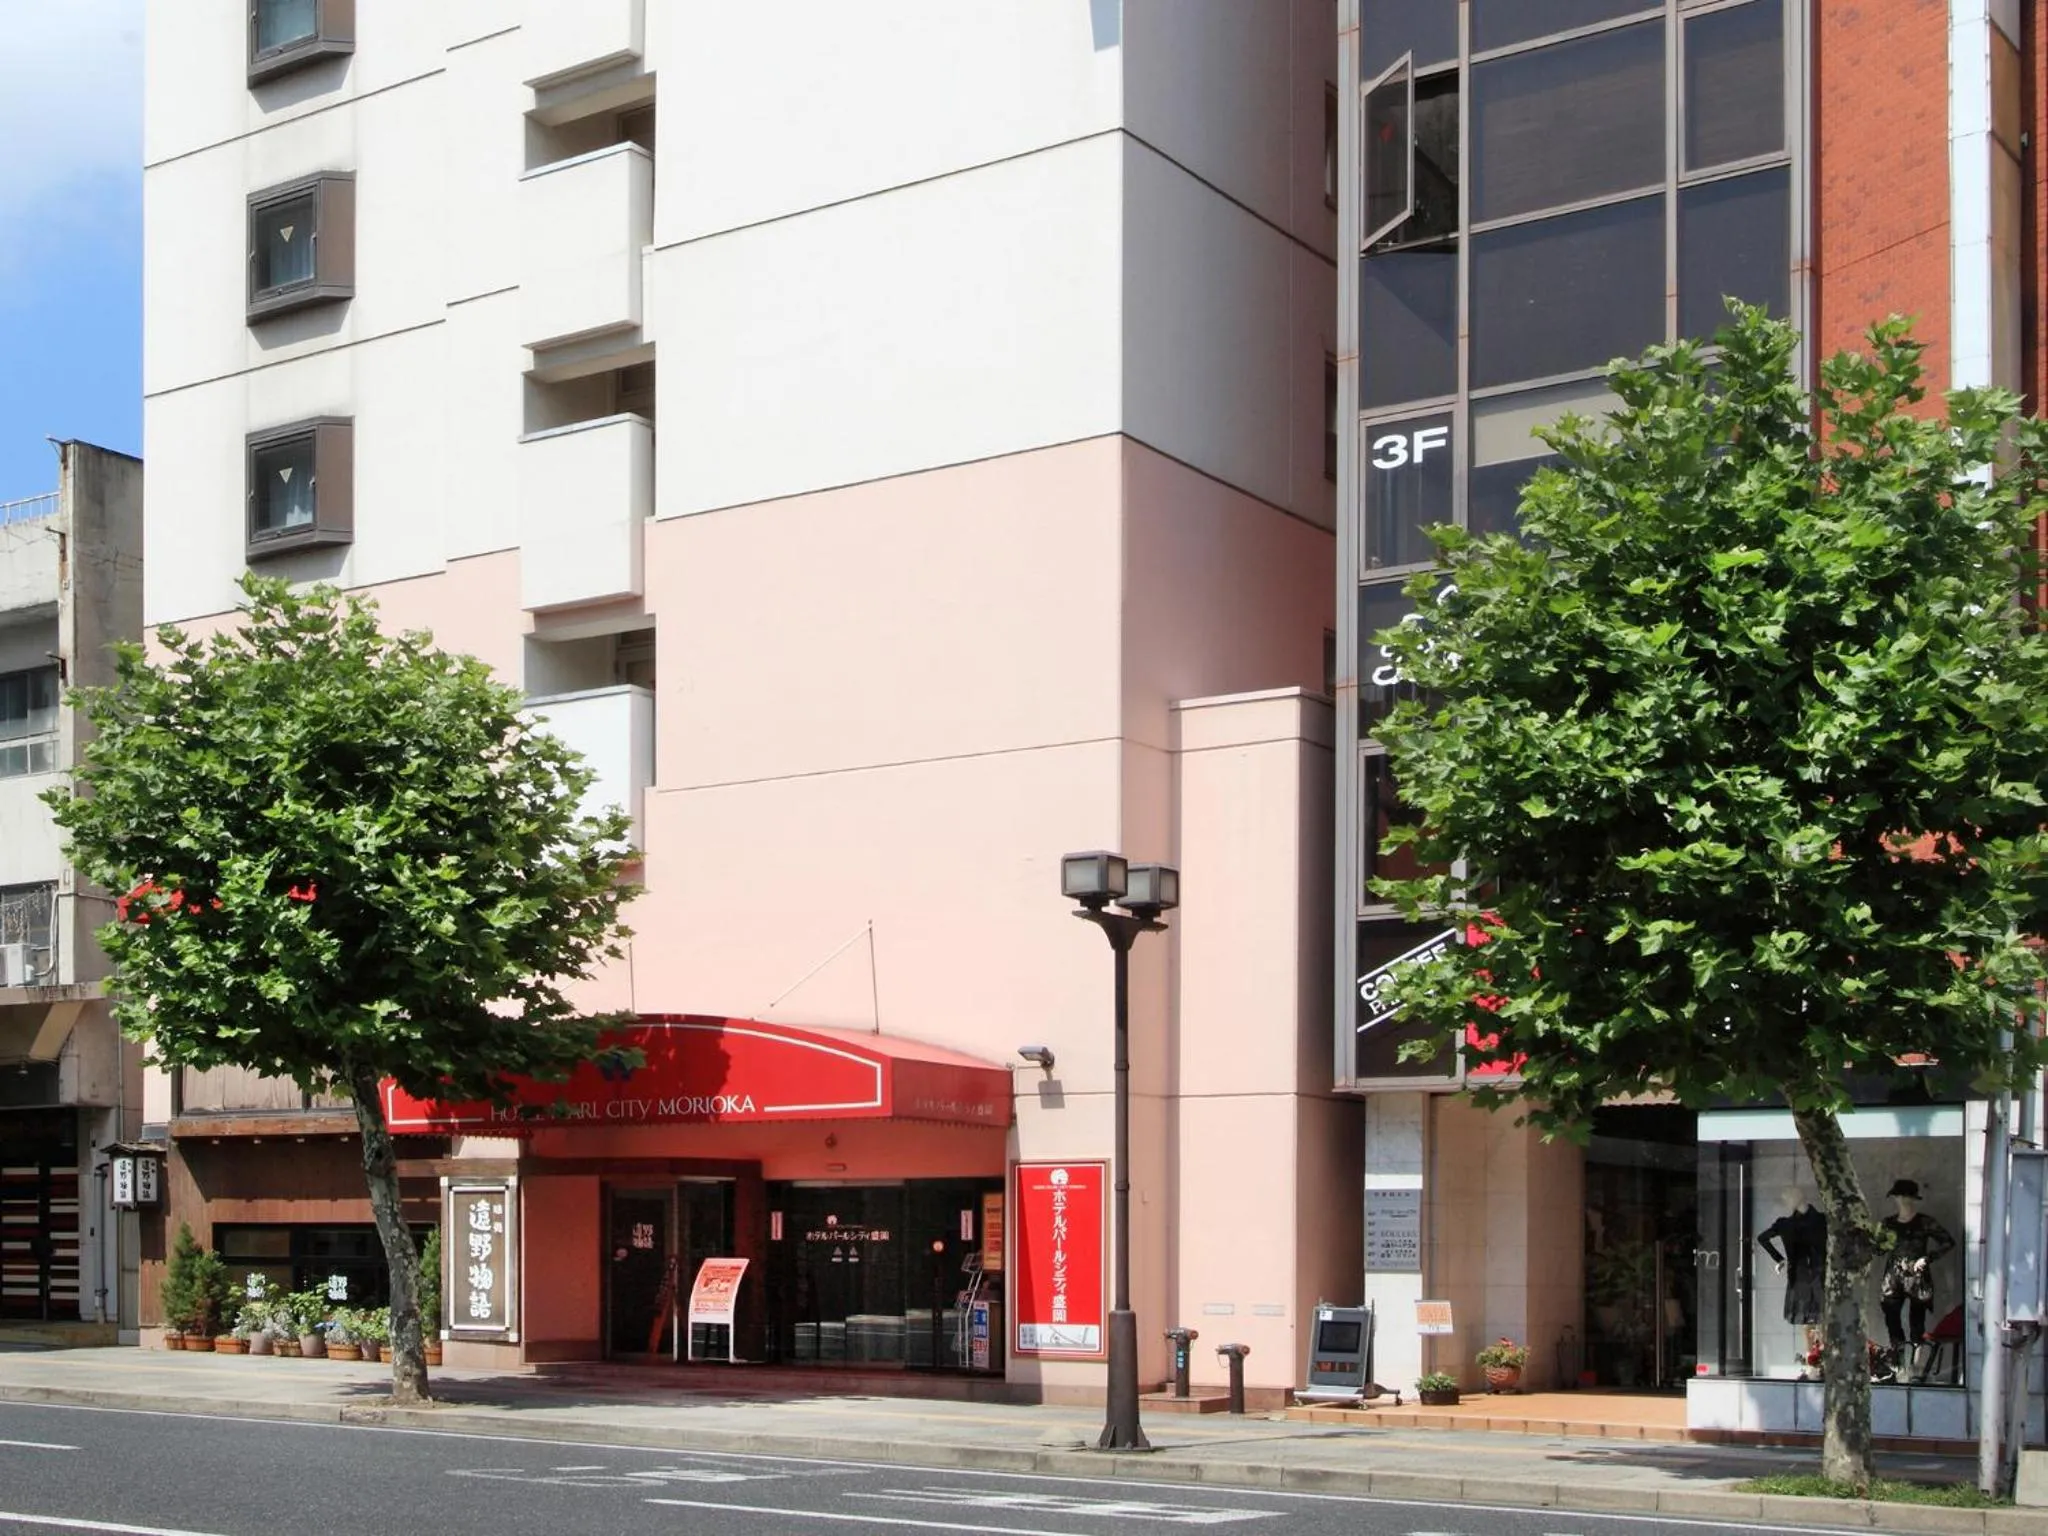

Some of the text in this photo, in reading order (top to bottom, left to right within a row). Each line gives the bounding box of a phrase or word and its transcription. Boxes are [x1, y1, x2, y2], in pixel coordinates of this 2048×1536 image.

[1371, 426, 1449, 470] 3F
[606, 1099, 652, 1119] CITY
[658, 1094, 755, 1115] MORIOKA
[468, 1198, 494, 1319] 遠野物語
[1052, 1190, 1068, 1323] ホテルパールシティ盛岡
